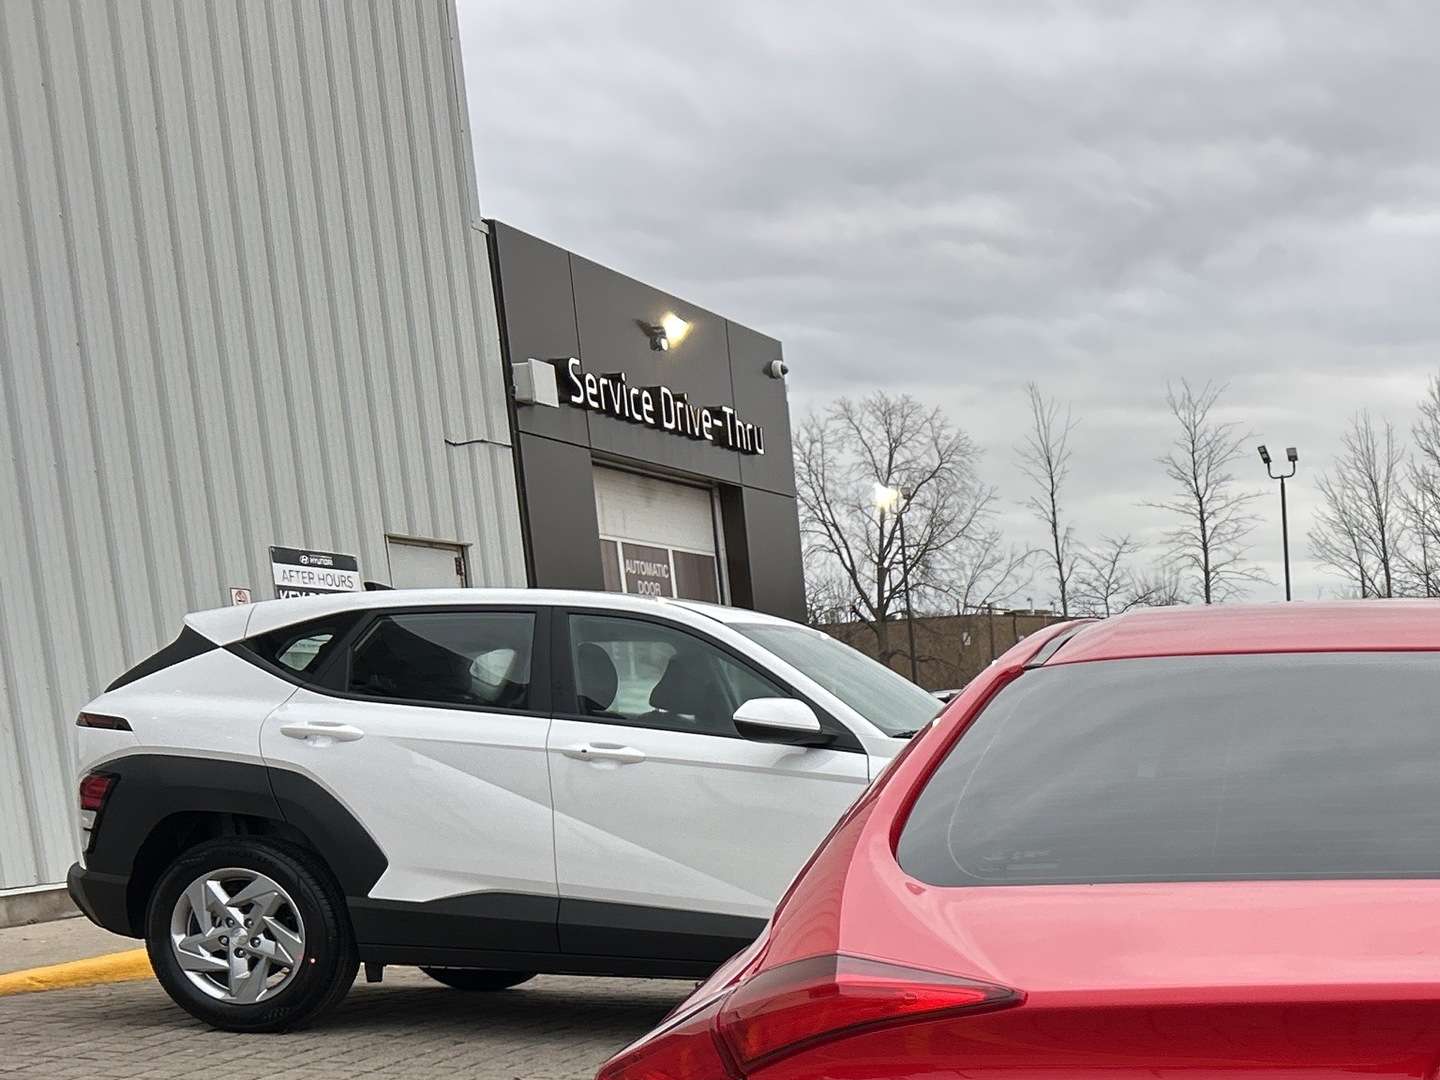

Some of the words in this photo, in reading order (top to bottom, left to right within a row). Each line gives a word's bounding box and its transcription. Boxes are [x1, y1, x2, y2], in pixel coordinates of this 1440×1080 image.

[568, 357, 655, 424] Service
[660, 386, 765, 455] Drive-Thru
[625, 559, 670, 578] AUTOMATIC
[281, 569, 315, 585] AFTER
[317, 573, 354, 589] HOURS
[637, 580, 662, 596] DOOR
